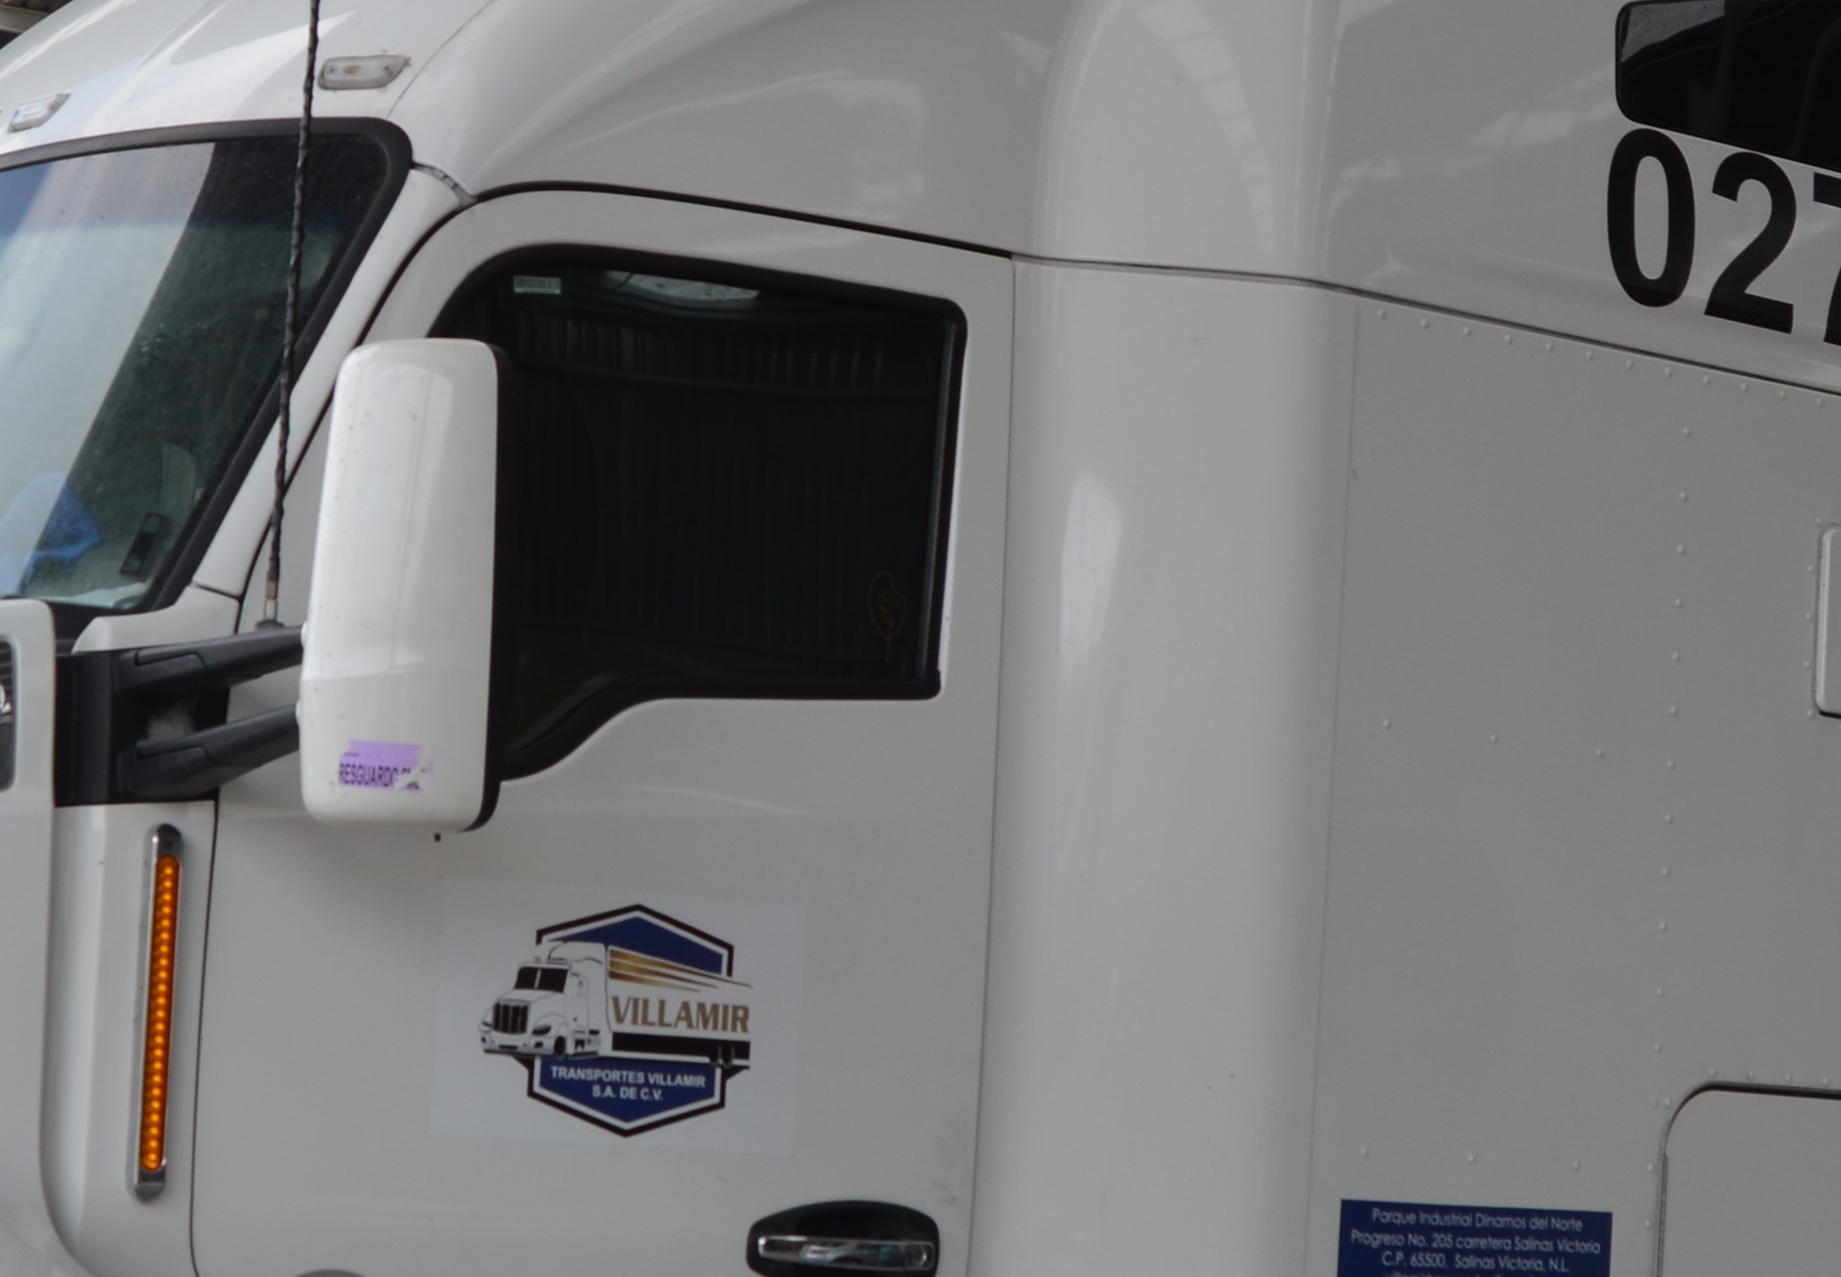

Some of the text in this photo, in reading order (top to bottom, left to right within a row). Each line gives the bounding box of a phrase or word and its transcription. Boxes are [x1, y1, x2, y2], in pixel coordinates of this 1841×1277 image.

[611, 995, 751, 1034] VILLAMIR
[550, 1065, 706, 1088] TRANSPORTES VILLAMIR
[592, 1085, 664, 1101] S.A. DE C.V.
[1372, 1208, 1583, 1231] Parque Industrial Dinamos del Norte
[1351, 1229, 1601, 1254] Progreso No. 205 carretera Salinas Victoria
[1382, 1251, 1407, 1266] C.P.
[1454, 1255, 1495, 1270] Salinas
[1548, 1258, 1570, 1272] N.L.
